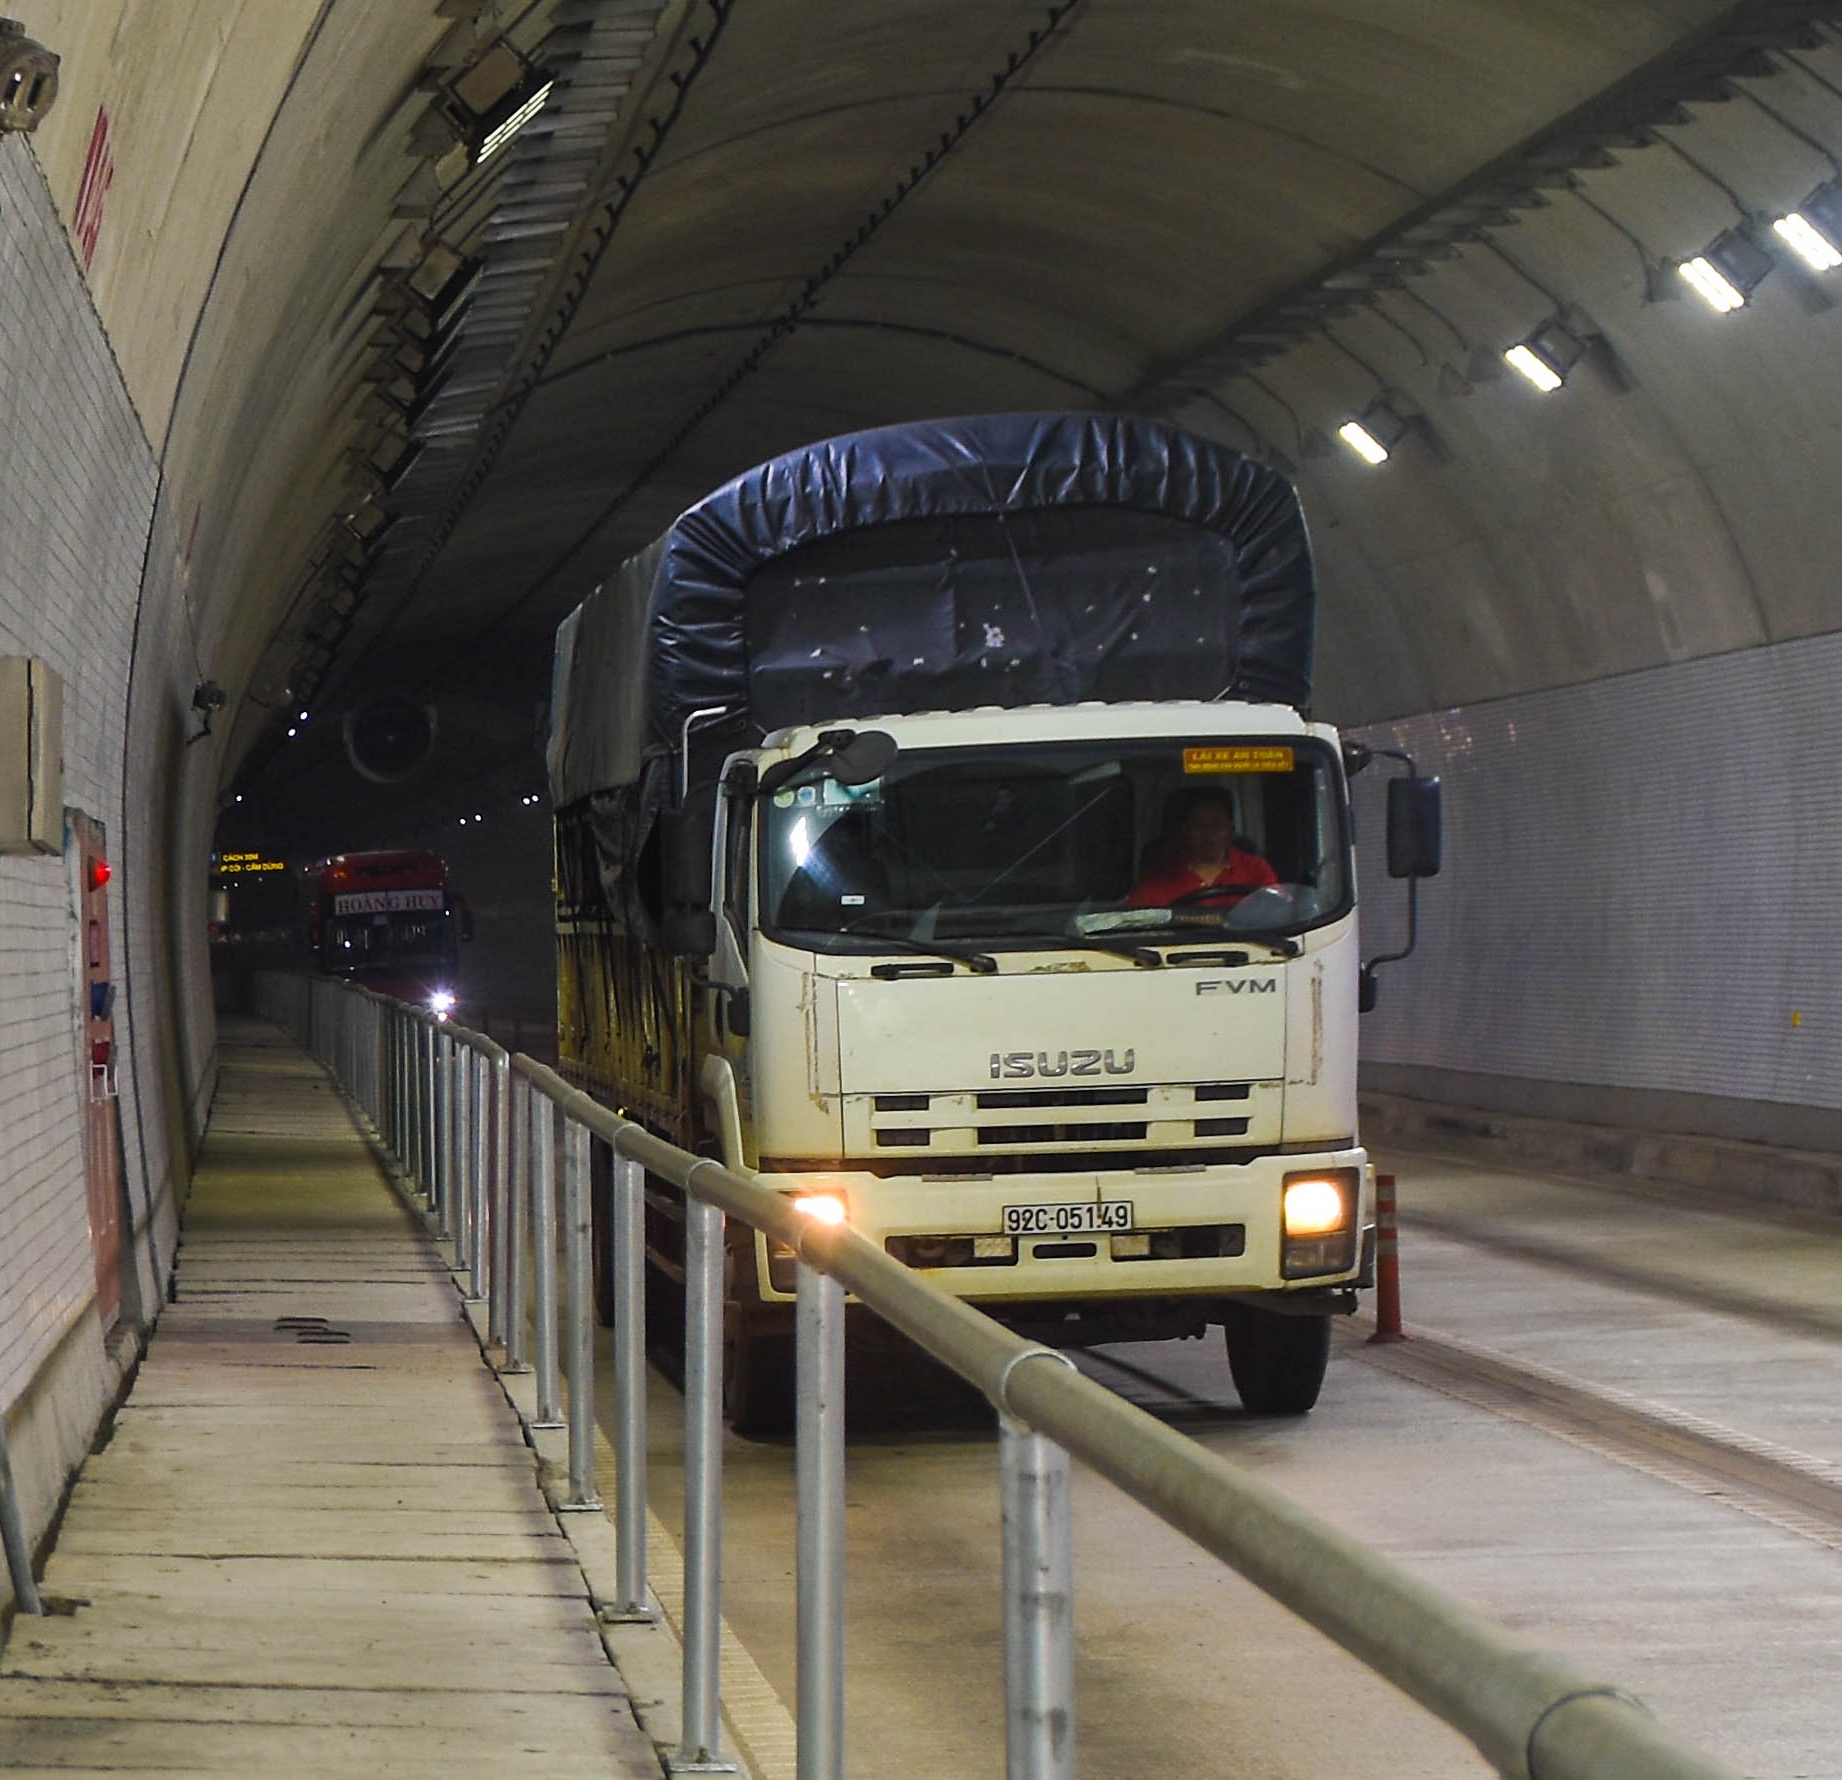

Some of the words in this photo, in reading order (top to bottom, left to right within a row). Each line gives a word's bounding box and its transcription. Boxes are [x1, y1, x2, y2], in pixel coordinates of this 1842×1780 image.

[406, 895, 441, 909] HUY
[1196, 979, 1277, 996] FVM
[990, 1048, 1135, 1079] ISUZU
